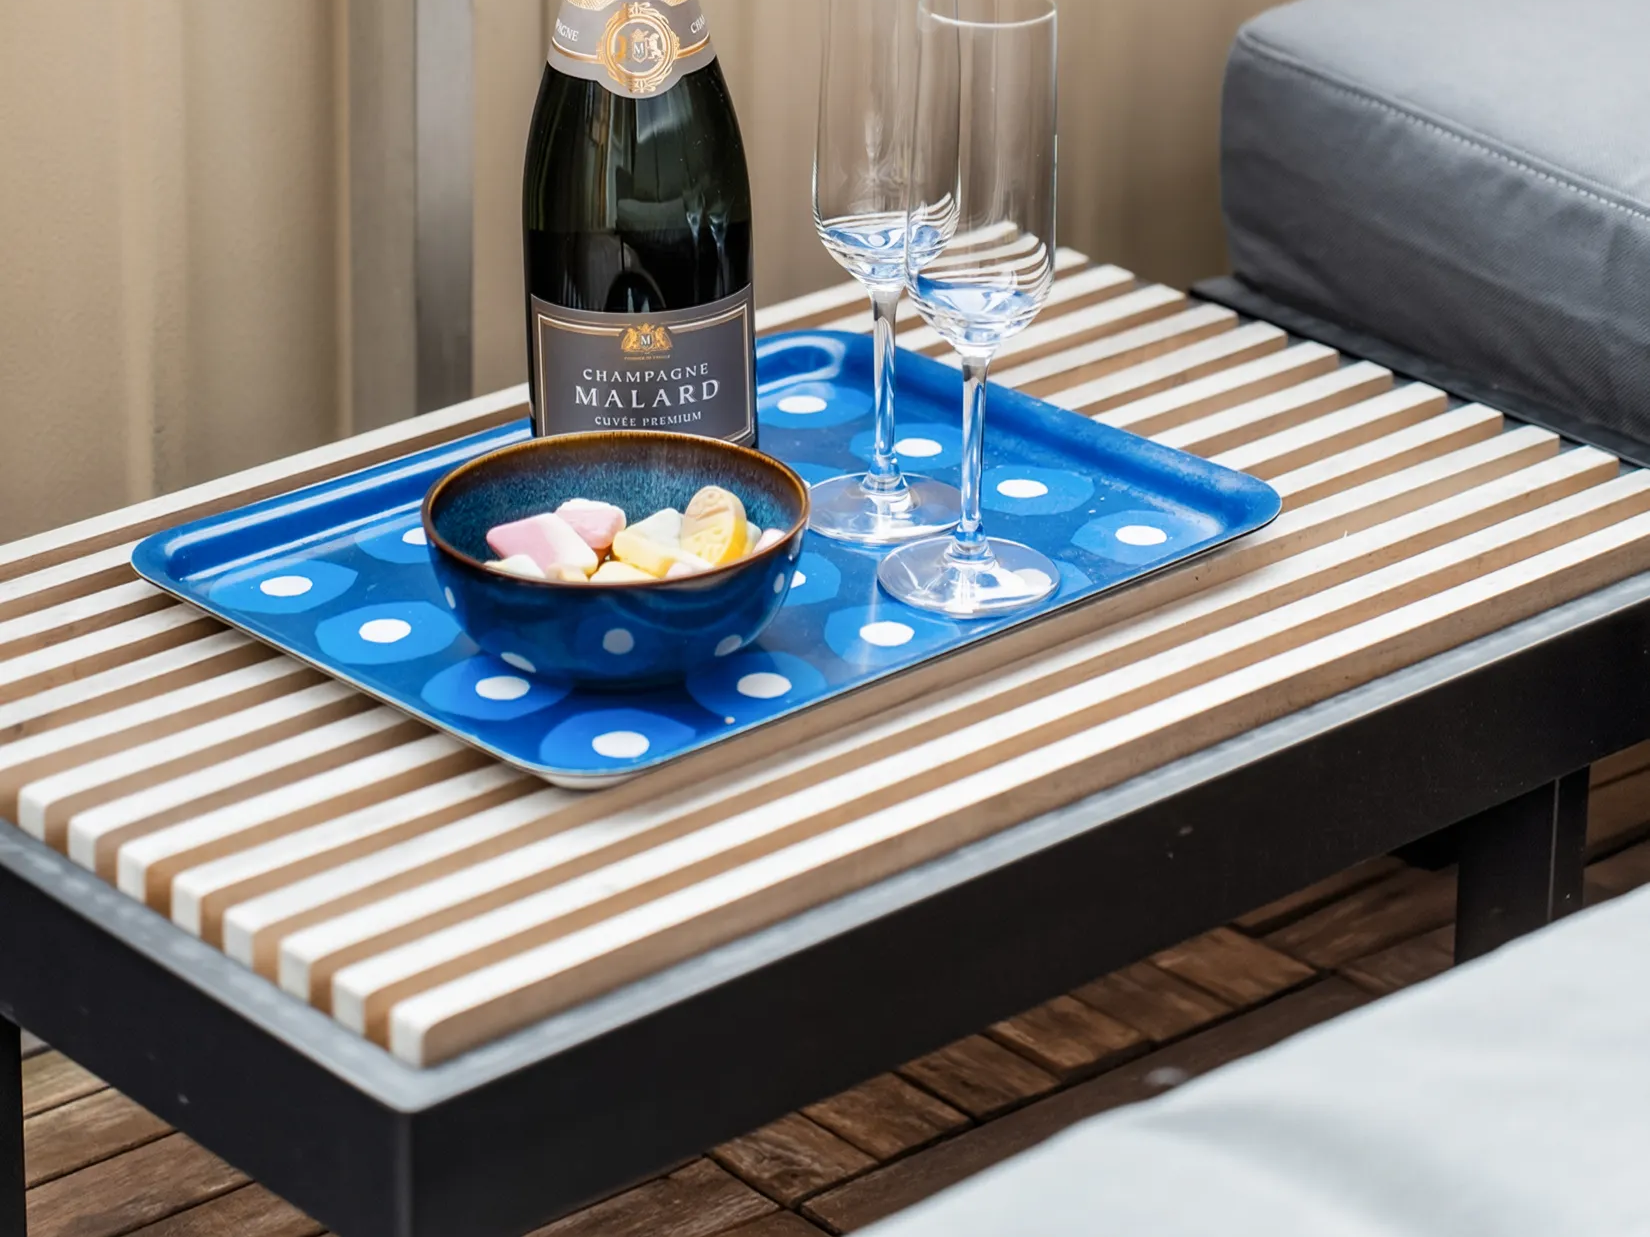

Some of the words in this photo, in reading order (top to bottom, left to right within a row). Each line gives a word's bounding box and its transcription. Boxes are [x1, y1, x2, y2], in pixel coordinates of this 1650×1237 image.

[633, 42, 644, 54] M
[641, 335, 650, 345] M
[583, 363, 709, 383] CHAMPAGNE
[575, 379, 720, 409] MALARD
[595, 416, 637, 427] CUVÉE
[642, 411, 702, 427] PREMIUM
